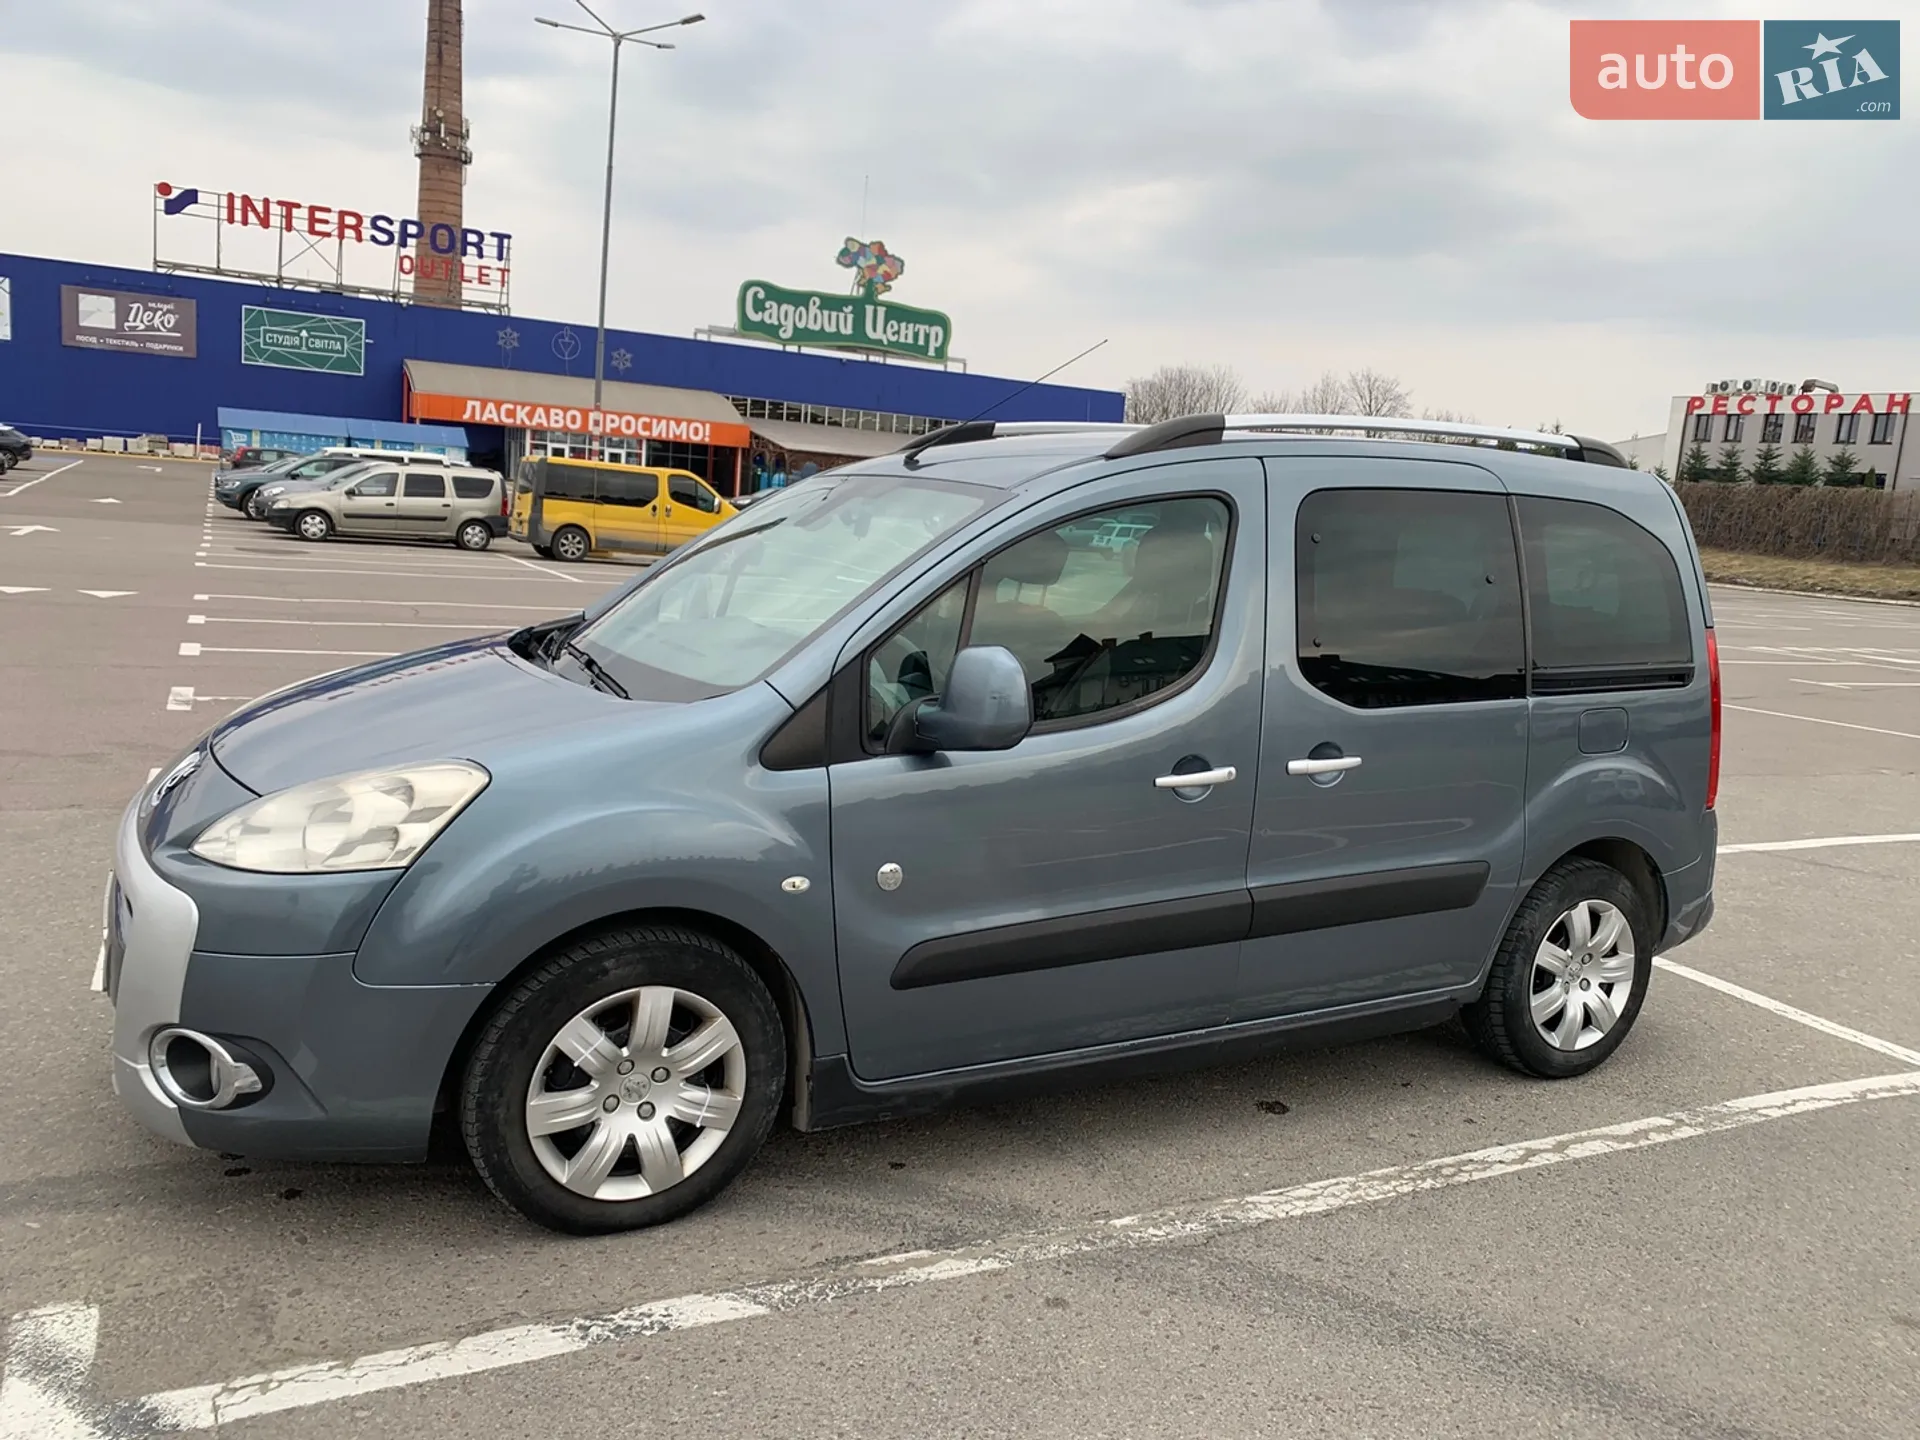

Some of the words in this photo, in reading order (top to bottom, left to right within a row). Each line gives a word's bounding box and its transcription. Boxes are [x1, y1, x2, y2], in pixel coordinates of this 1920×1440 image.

[226, 191, 512, 262] INTERSPORT
[399, 254, 510, 287] OUTLET
[123, 302, 176, 332] Деко
[745, 286, 854, 340] Садовий
[864, 304, 944, 356] Центр
[105, 338, 139, 348] ТЕКСТИЛЬ
[266, 333, 300, 346] СТУДІЯ
[308, 338, 342, 351] СВІТЛА
[463, 400, 582, 430] ЛАСКАВО
[1687, 393, 1911, 415] РЕСТОРАН
